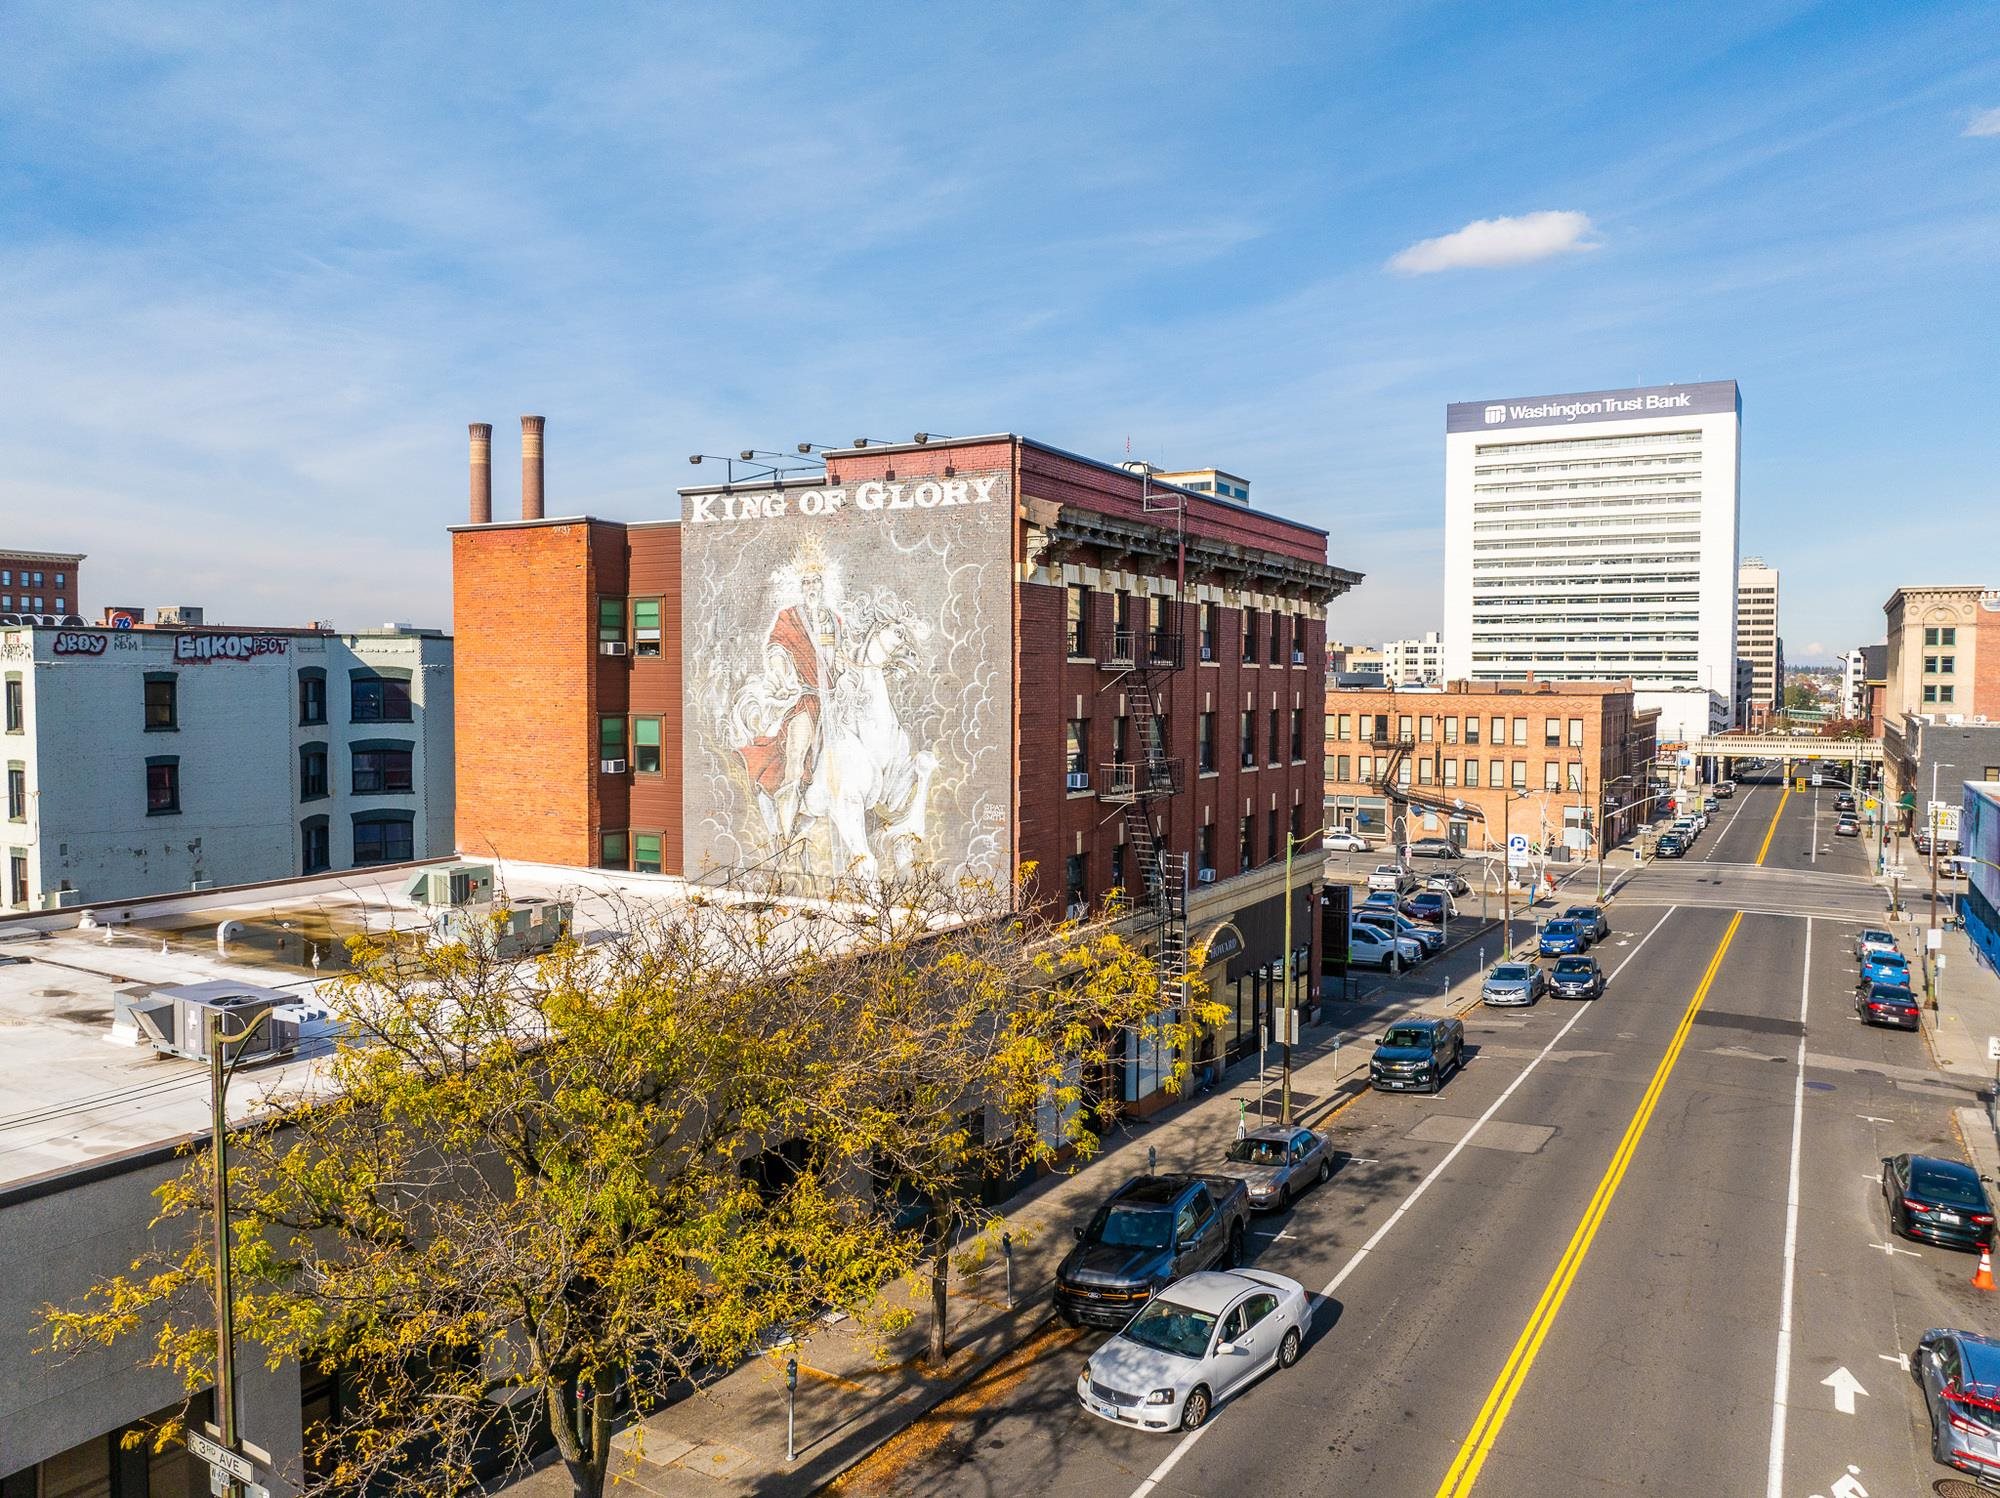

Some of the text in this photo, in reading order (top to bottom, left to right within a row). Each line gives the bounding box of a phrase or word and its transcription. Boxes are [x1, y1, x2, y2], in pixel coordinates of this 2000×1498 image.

[1510, 393, 1691, 422] Washington Trust Bank
[690, 476, 998, 523] KING OF GLORY
[114, 617, 131, 629] 76
[199, 1441, 216, 1455] 3RD
